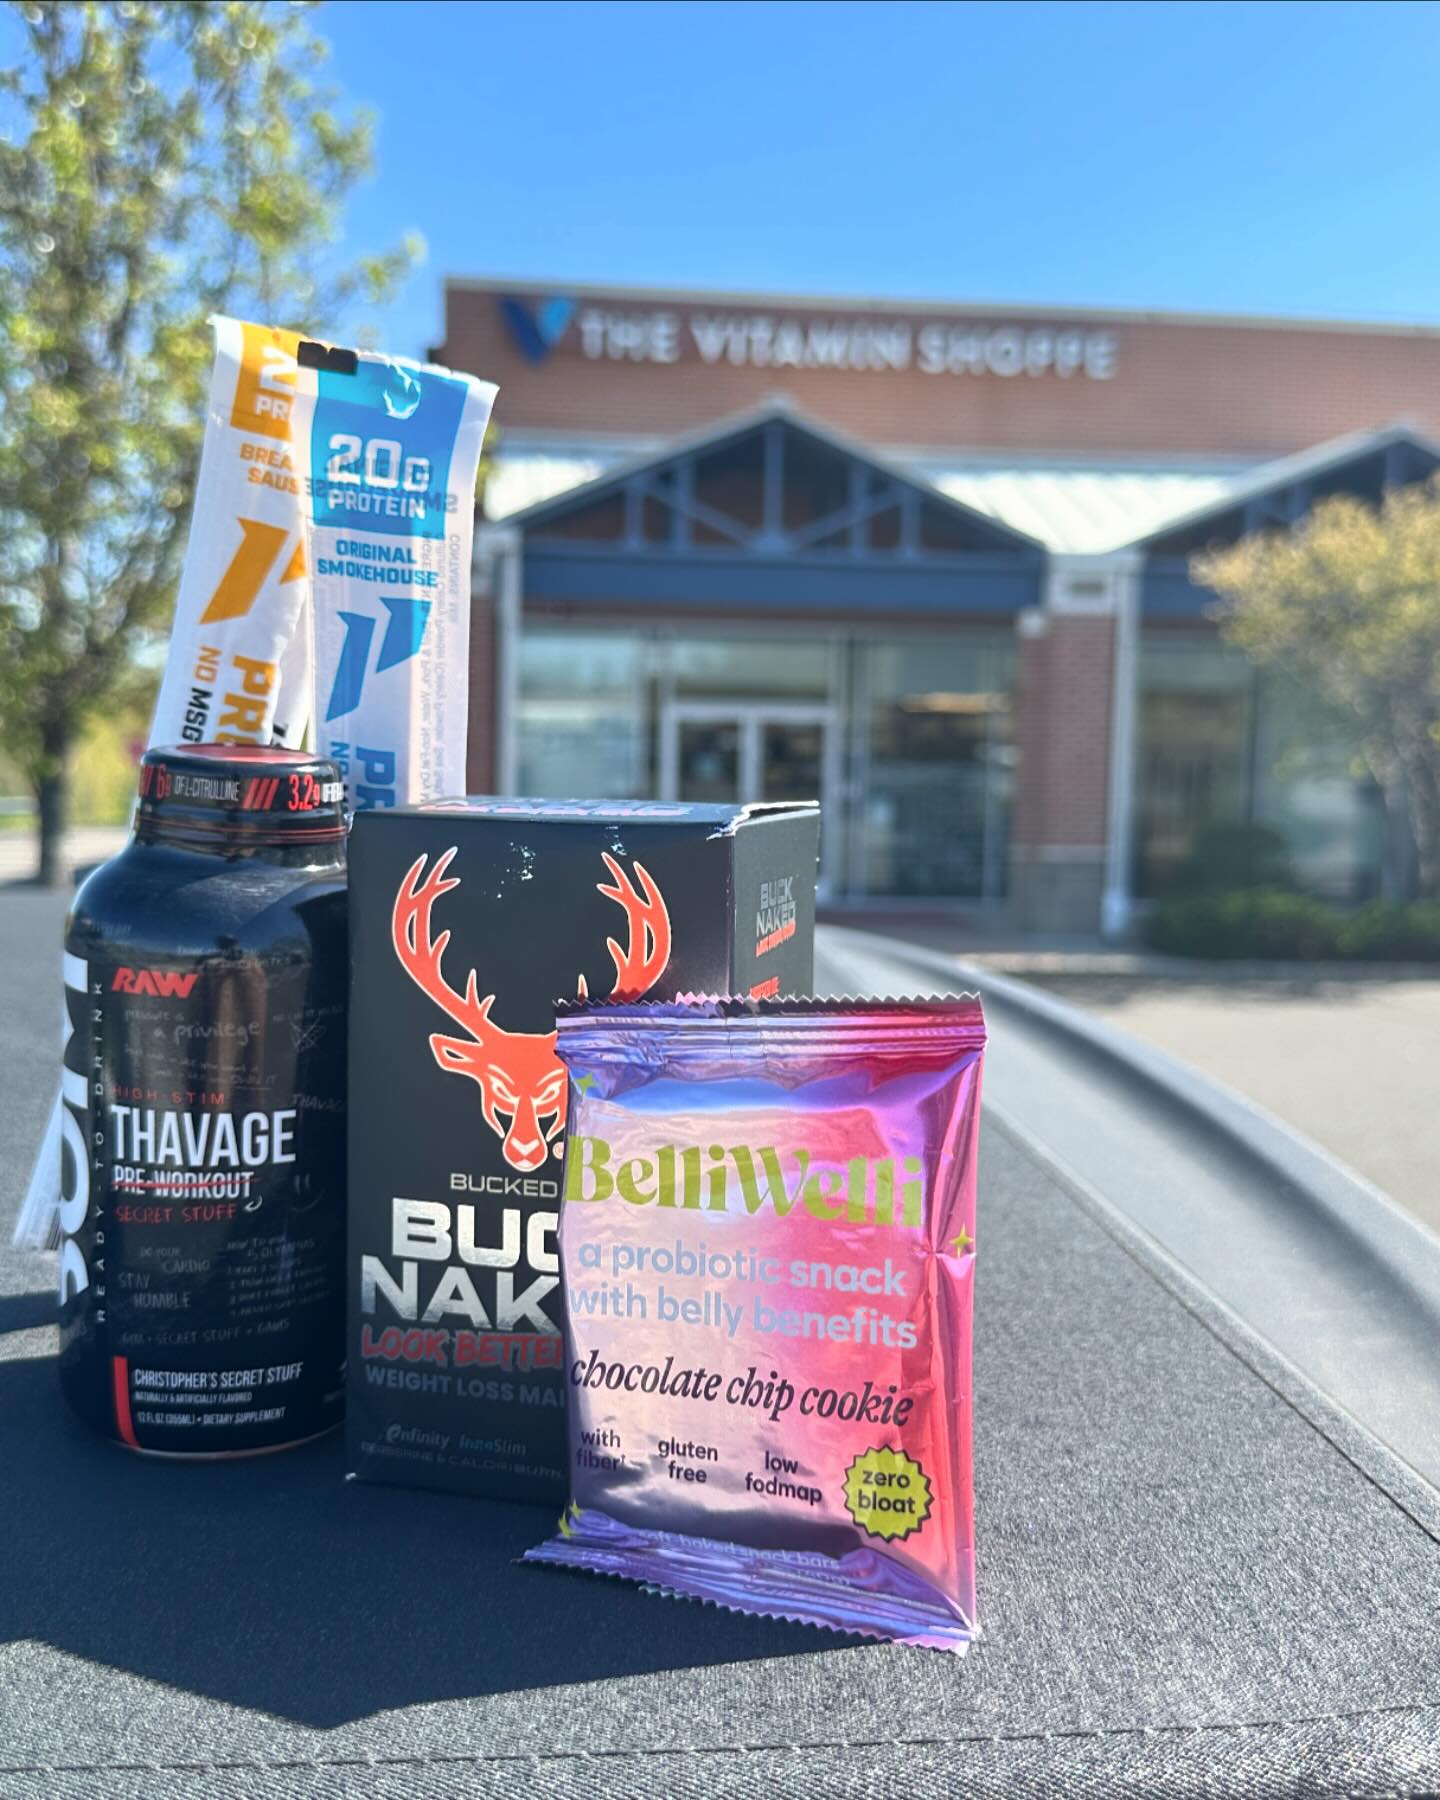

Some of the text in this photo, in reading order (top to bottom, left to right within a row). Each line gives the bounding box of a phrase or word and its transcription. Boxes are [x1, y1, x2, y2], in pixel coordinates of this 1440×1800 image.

[579, 308, 680, 364] THE
[690, 314, 912, 371] VITAMIN
[918, 321, 1119, 380] SHOPPE
[247, 466, 300, 495] SAUS
[328, 490, 426, 520] PROTEIN
[335, 539, 417, 564] ORIGINAL
[317, 559, 438, 588] SMOKEHOUSE
[182, 646, 222, 744] NO MSG
[214, 655, 278, 745] PR
[288, 773, 321, 812] 3.2g
[760, 876, 794, 909] BUCK
[756, 902, 796, 937] NAKED
[112, 967, 199, 999] RAW
[174, 1021, 260, 1046] privilege
[171, 1090, 225, 1106] STIM
[111, 1103, 297, 1167] THAVAGE
[113, 1165, 255, 1199] PRE-WORKOUT
[450, 1173, 558, 1198] BUCKED
[566, 1135, 925, 1228] BelliWelli
[115, 1203, 237, 1225] SECRET STUFF
[392, 1197, 560, 1273] BUC
[578, 1240, 907, 1296] a probiotic snack
[361, 1254, 563, 1335] NAK
[569, 1281, 918, 1349] with belly benefits
[361, 1324, 450, 1367] LOOK
[134, 1361, 304, 1389] CHRISTOPHER'S SECRET STUFF
[365, 1364, 453, 1394] WEIGHT
[457, 1379, 514, 1402] LOSS
[570, 1349, 914, 1427] chocolate chip cookie
[235, 1407, 286, 1423] SUPPLEMENT
[580, 1427, 621, 1449] with
[657, 1437, 719, 1463] gluten
[668, 1459, 708, 1484] free
[764, 1451, 799, 1475] low
[862, 1468, 912, 1489] zero
[745, 1474, 823, 1506] fodmap
[857, 1487, 916, 1515] bloat
